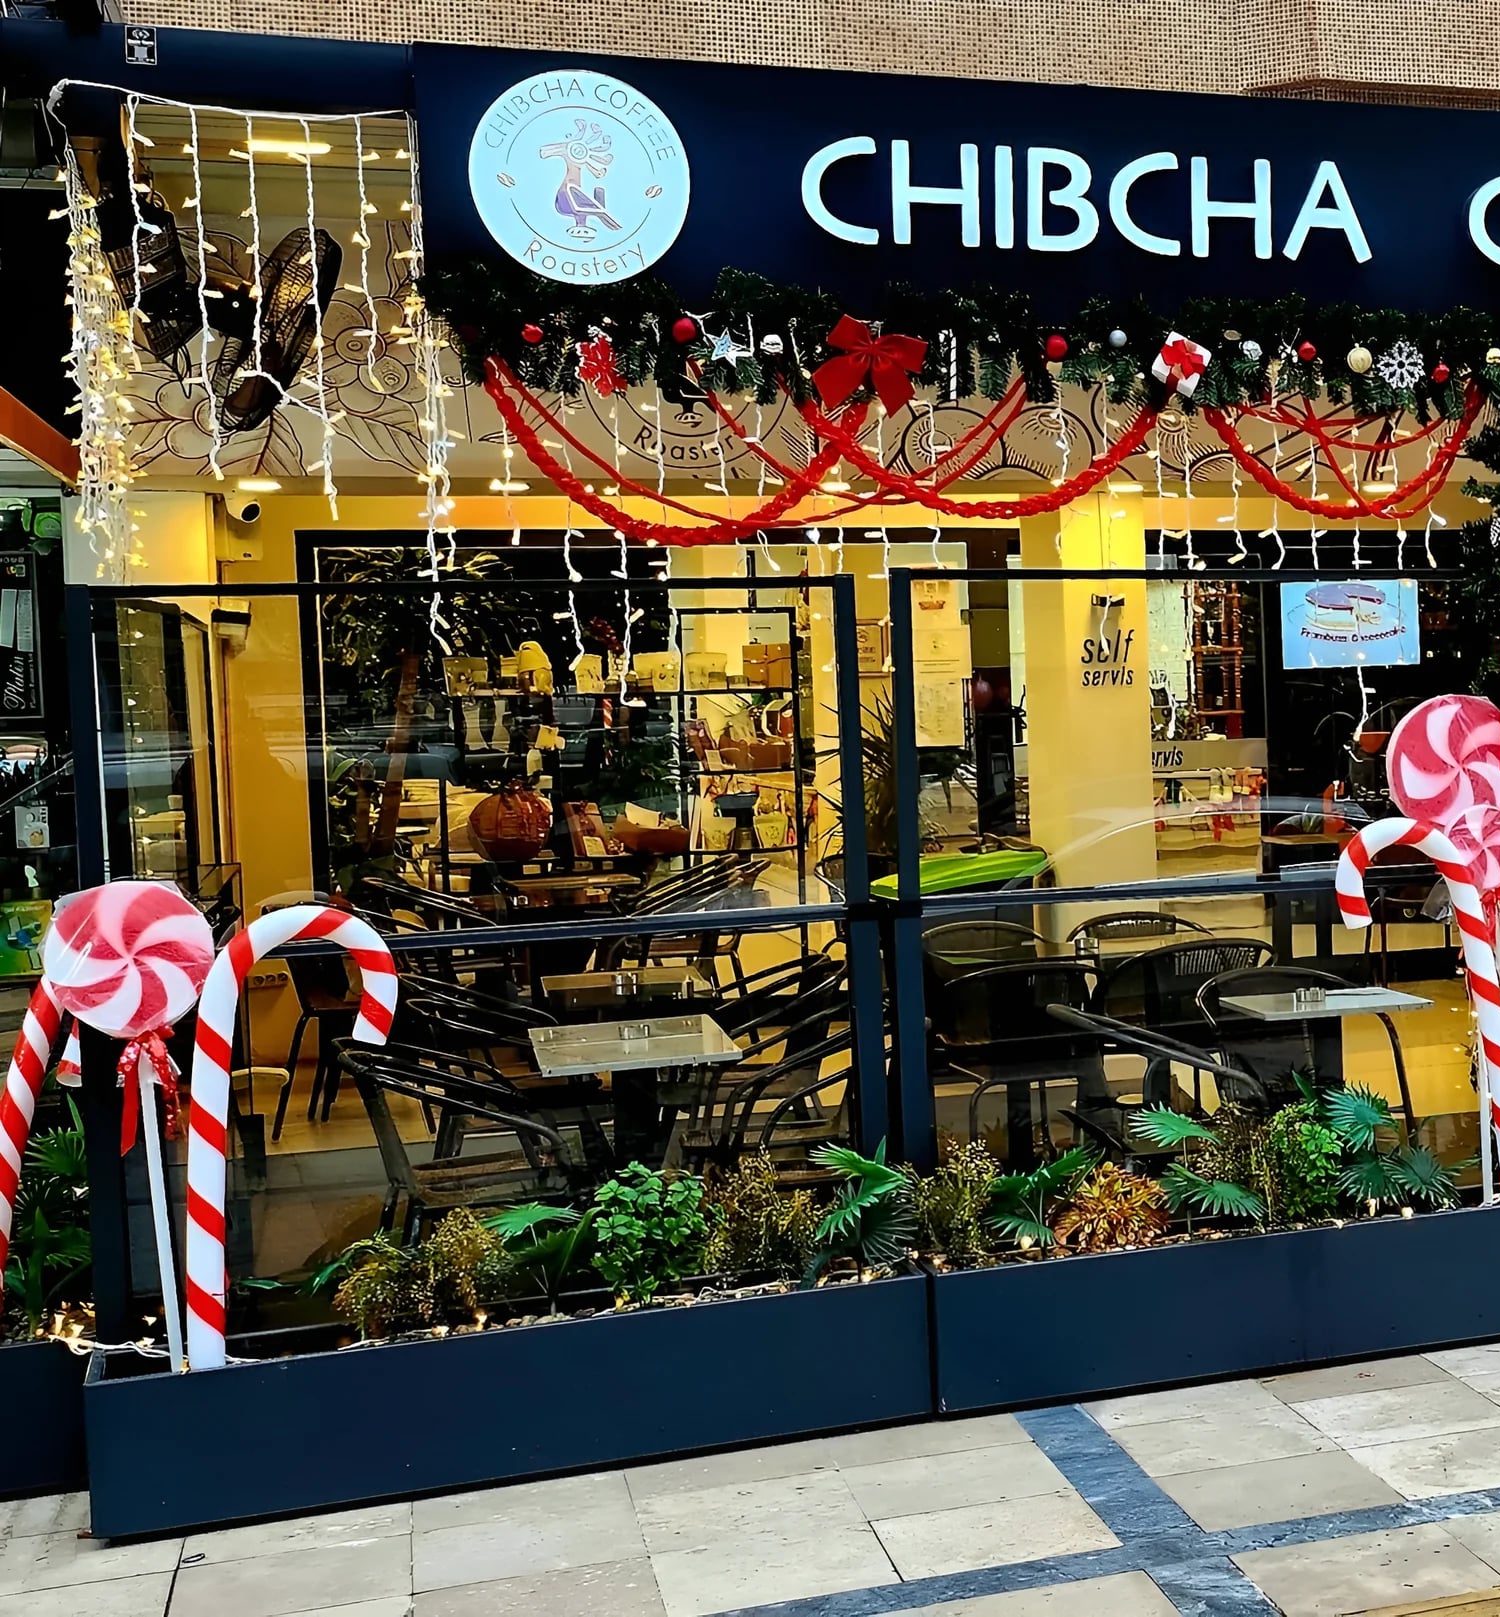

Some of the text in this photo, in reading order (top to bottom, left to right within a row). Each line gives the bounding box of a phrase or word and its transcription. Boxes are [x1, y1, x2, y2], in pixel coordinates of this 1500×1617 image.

[485, 79, 677, 161] CHIBCHA COFFEE
[801, 136, 1373, 264] CHIBCHA
[523, 239, 646, 277] Roastery
[1081, 629, 1135, 664] self
[1082, 666, 1134, 687] servis
